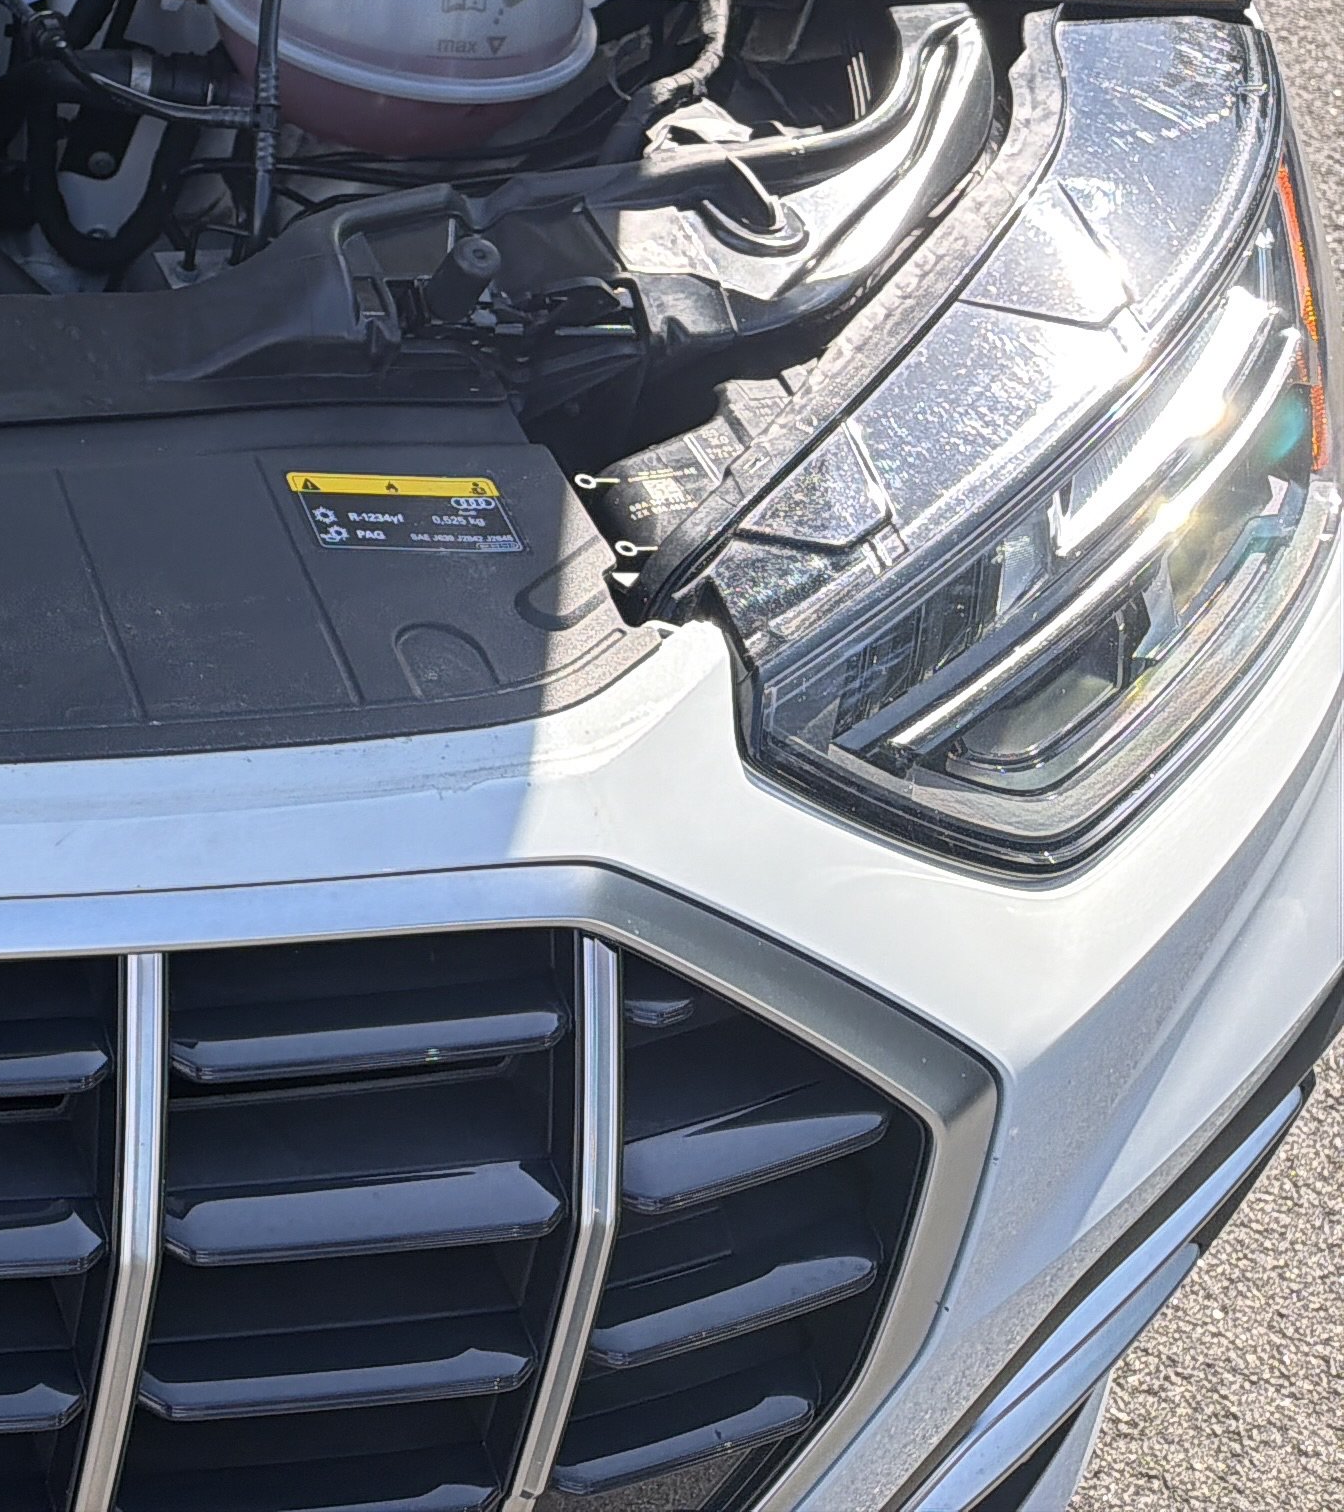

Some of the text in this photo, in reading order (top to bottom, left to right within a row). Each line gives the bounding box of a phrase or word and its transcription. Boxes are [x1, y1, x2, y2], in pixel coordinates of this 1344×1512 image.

[437, 38, 477, 54] max
[468, 518, 486, 526] kg
[357, 530, 386, 540] PAG
